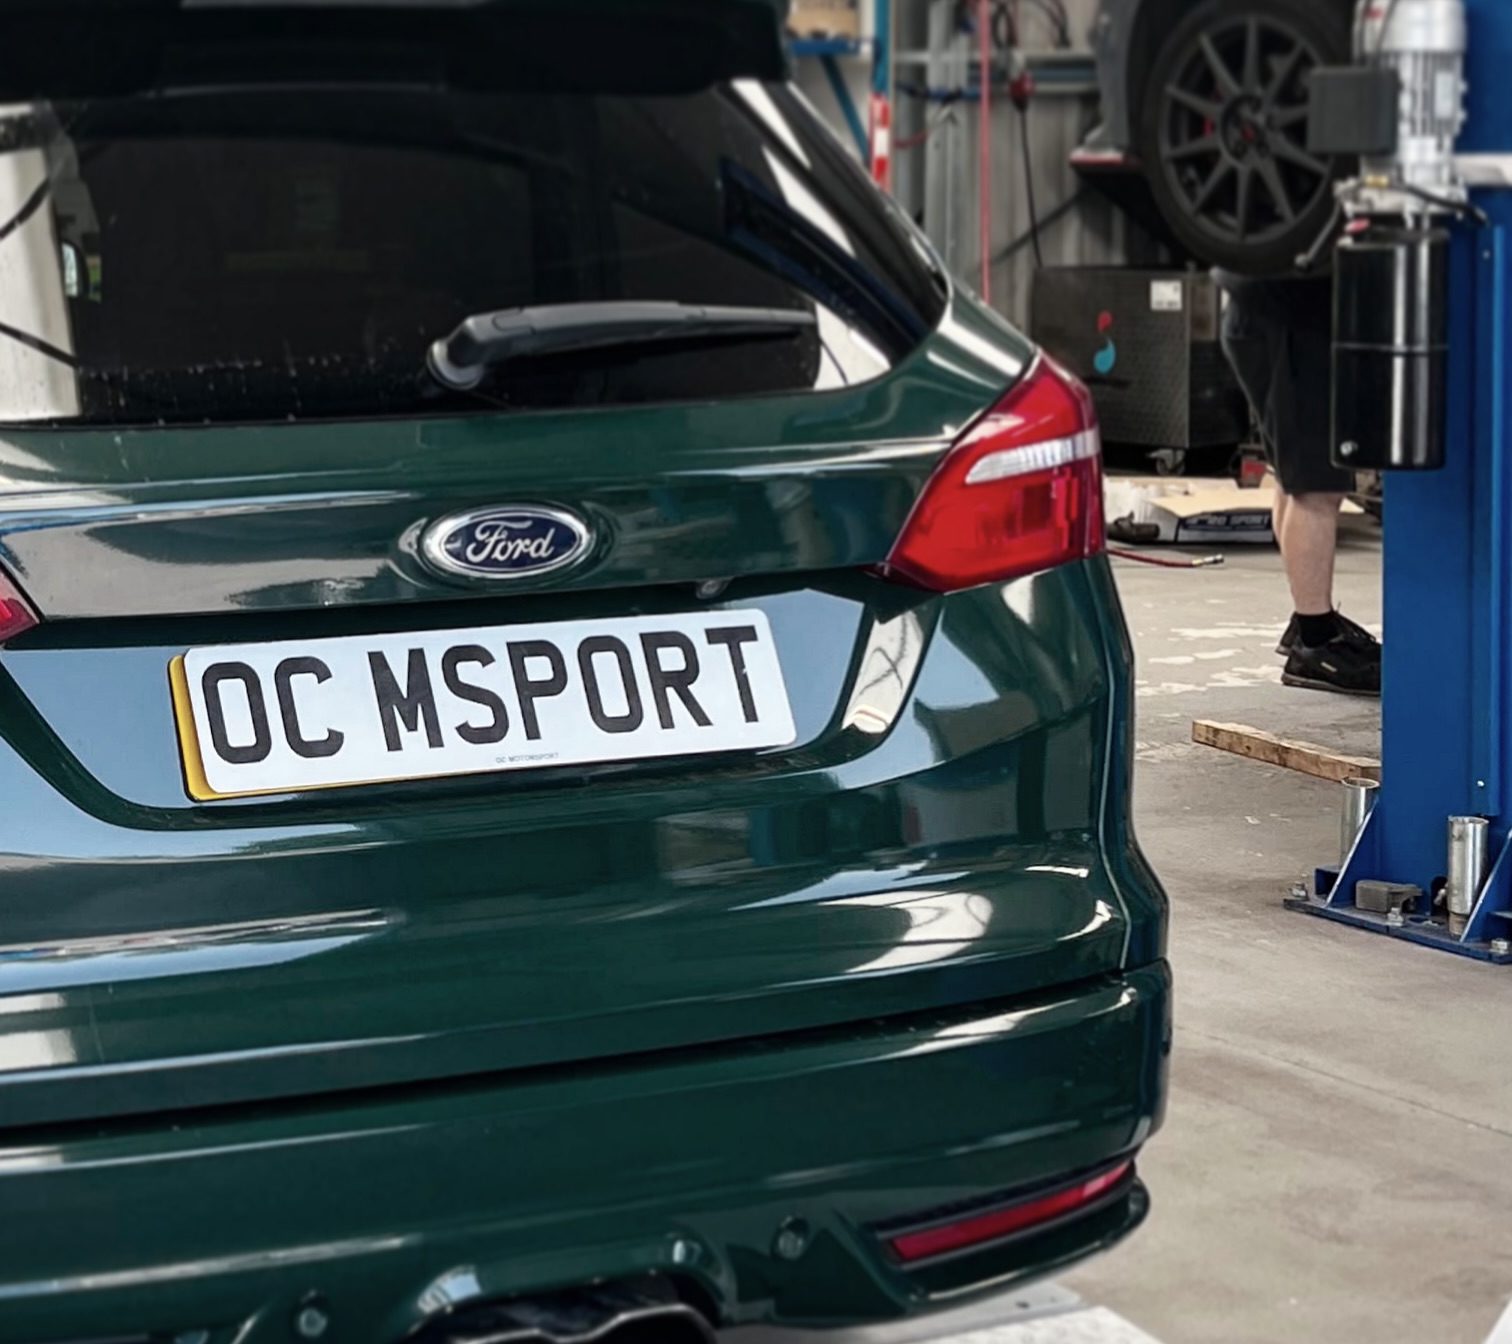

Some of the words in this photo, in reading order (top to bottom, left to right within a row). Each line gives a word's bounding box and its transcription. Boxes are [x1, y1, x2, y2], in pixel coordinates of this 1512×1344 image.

[465, 511, 556, 564] Ford
[201, 656, 345, 765] OC
[367, 624, 763, 753] MSPORT
